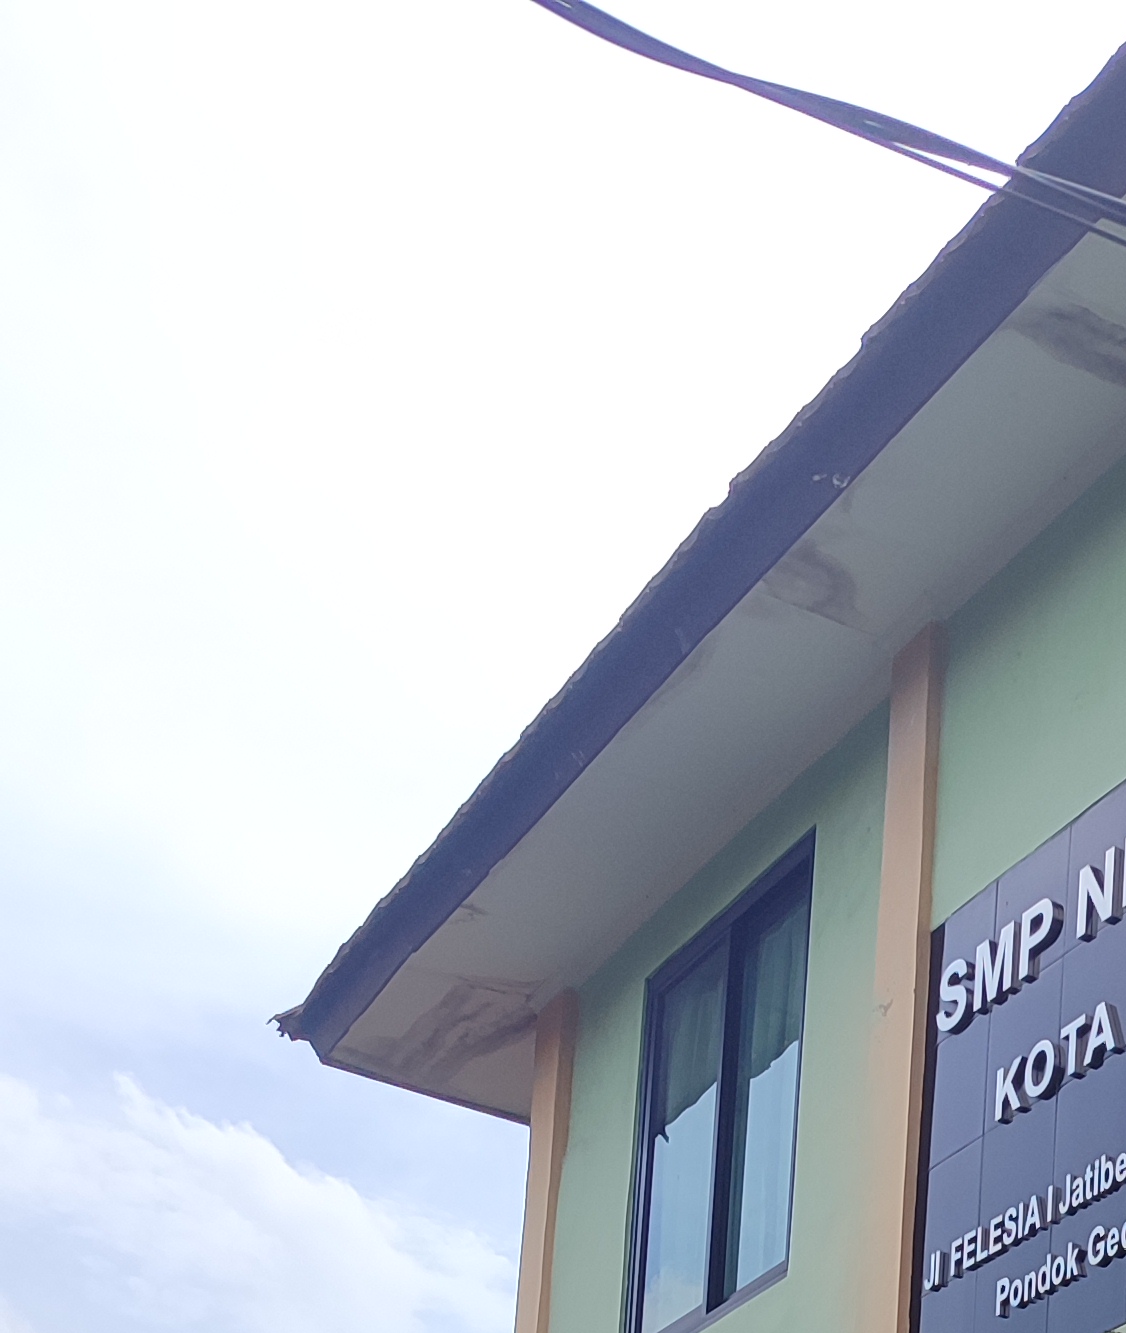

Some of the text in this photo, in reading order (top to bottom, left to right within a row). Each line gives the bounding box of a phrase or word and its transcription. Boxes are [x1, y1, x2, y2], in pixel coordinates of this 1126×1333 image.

[936, 897, 1058, 1034] SMP
[995, 1001, 1121, 1123] KOTA
[950, 1194, 1044, 1277] FELESIA
[995, 1242, 1082, 1317] Pondok
